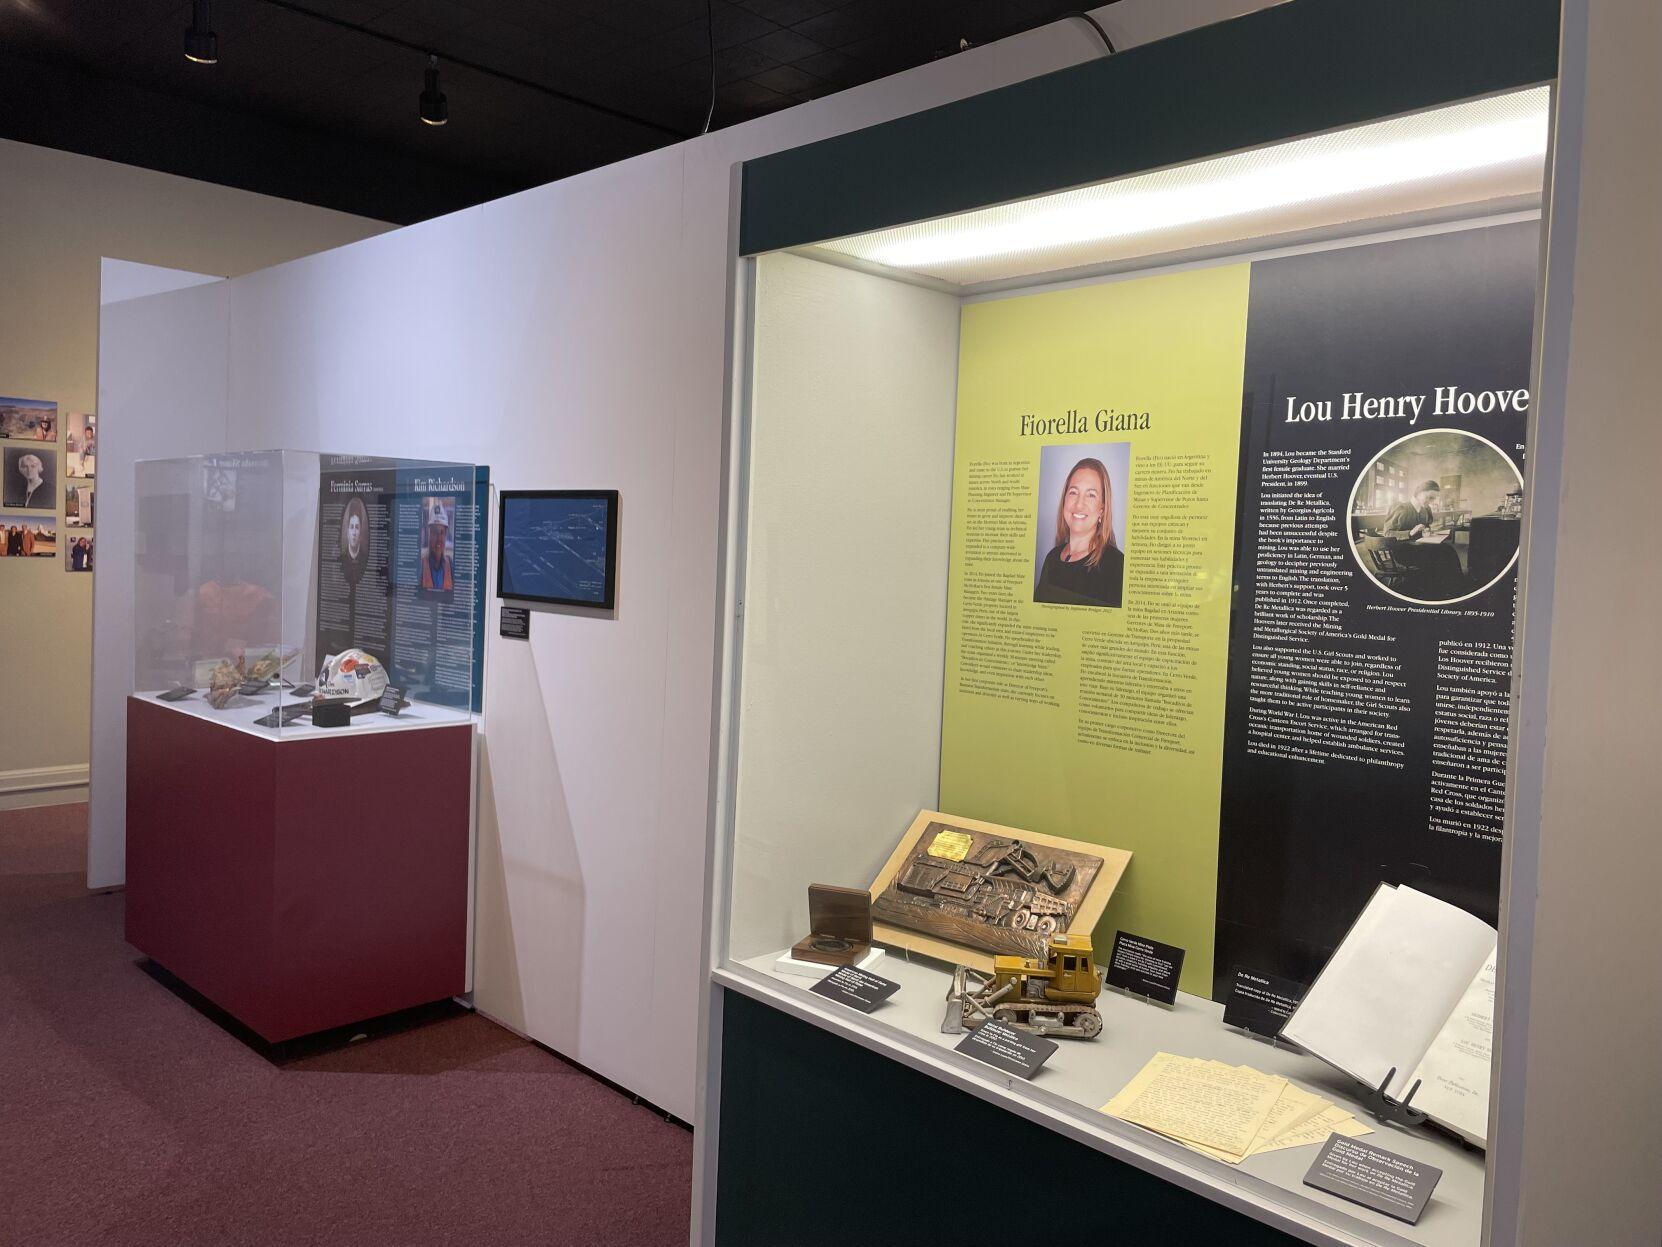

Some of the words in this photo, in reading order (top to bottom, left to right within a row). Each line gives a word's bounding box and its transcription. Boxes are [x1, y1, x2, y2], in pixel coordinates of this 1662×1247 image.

[1285, 396, 1332, 423] Lou
[1341, 393, 1426, 424] Henry
[1433, 386, 1529, 415] Hoove
[1020, 410, 1088, 436] Fiorella
[1096, 409, 1151, 432] Giana
[414, 479, 426, 491] Kim
[428, 477, 465, 491] Richardson
[1438, 663, 1480, 673] Distinguished
[1437, 671, 1459, 681] Society
[1450, 686, 1475, 694] también
[1460, 720, 1487, 728] deberían
[1434, 734, 1480, 745] autosuficiencia
[1433, 750, 1465, 760] tradicional
[1483, 766, 1506, 775] particip
[1432, 771, 1456, 780] Durante
[1466, 775, 1490, 784] Primera
[1431, 780, 1469, 789] activamente
[1465, 801, 1492, 810] soldados
[1461, 808, 1493, 818] establecer
[1436, 825, 1467, 836] filantropía
[1491, 825, 1504, 834] desp
[1251, 976, 1269, 985] Metallica
[1332, 1147, 1345, 1155] Gold
[1346, 1152, 1363, 1161] Medal
[1351, 1144, 1368, 1153] Medal
[1369, 1150, 1391, 1162] Remark
